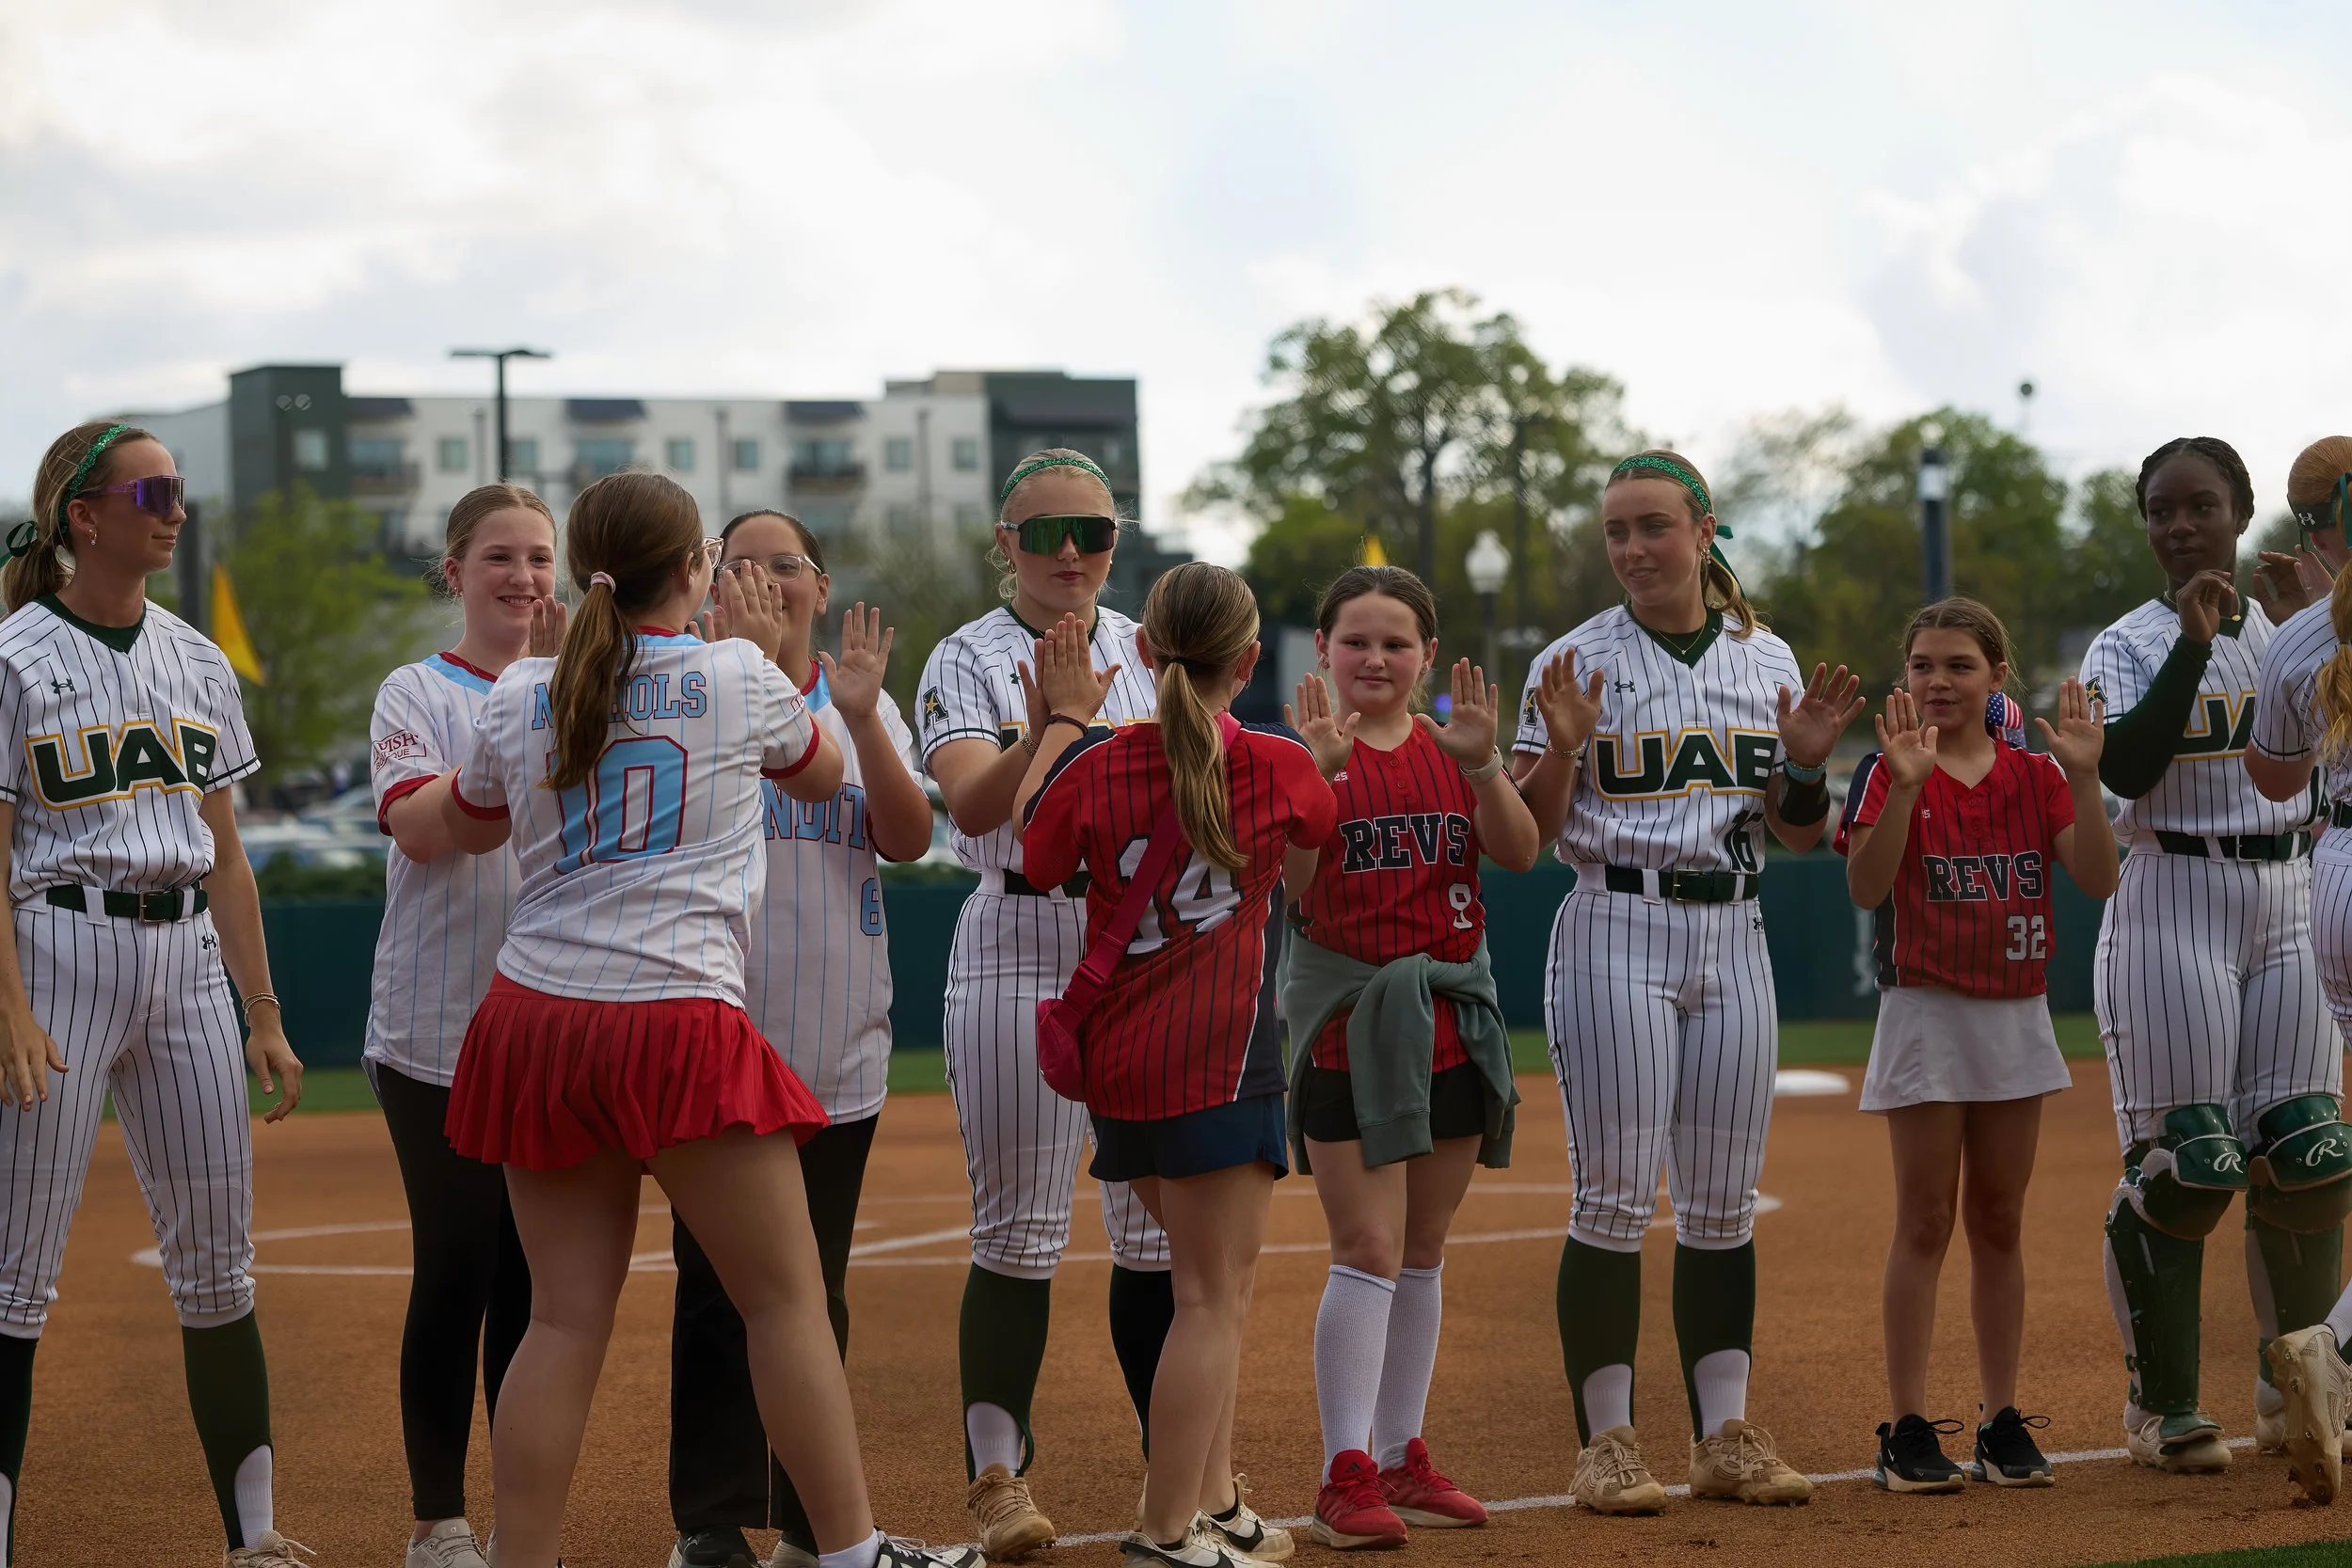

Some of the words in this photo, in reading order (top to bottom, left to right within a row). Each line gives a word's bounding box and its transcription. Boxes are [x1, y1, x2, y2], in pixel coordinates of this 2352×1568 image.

[532, 672, 707, 730] NHOLS
[24, 717, 220, 811] UAB
[1592, 727, 1780, 802] UAB
[546, 735, 689, 875] 10
[760, 777, 866, 851] NDIT
[1339, 812, 1470, 874] REVS
[1448, 882, 1473, 929] 9
[1922, 849, 2043, 902] REVS
[2006, 914, 2047, 960] 32
